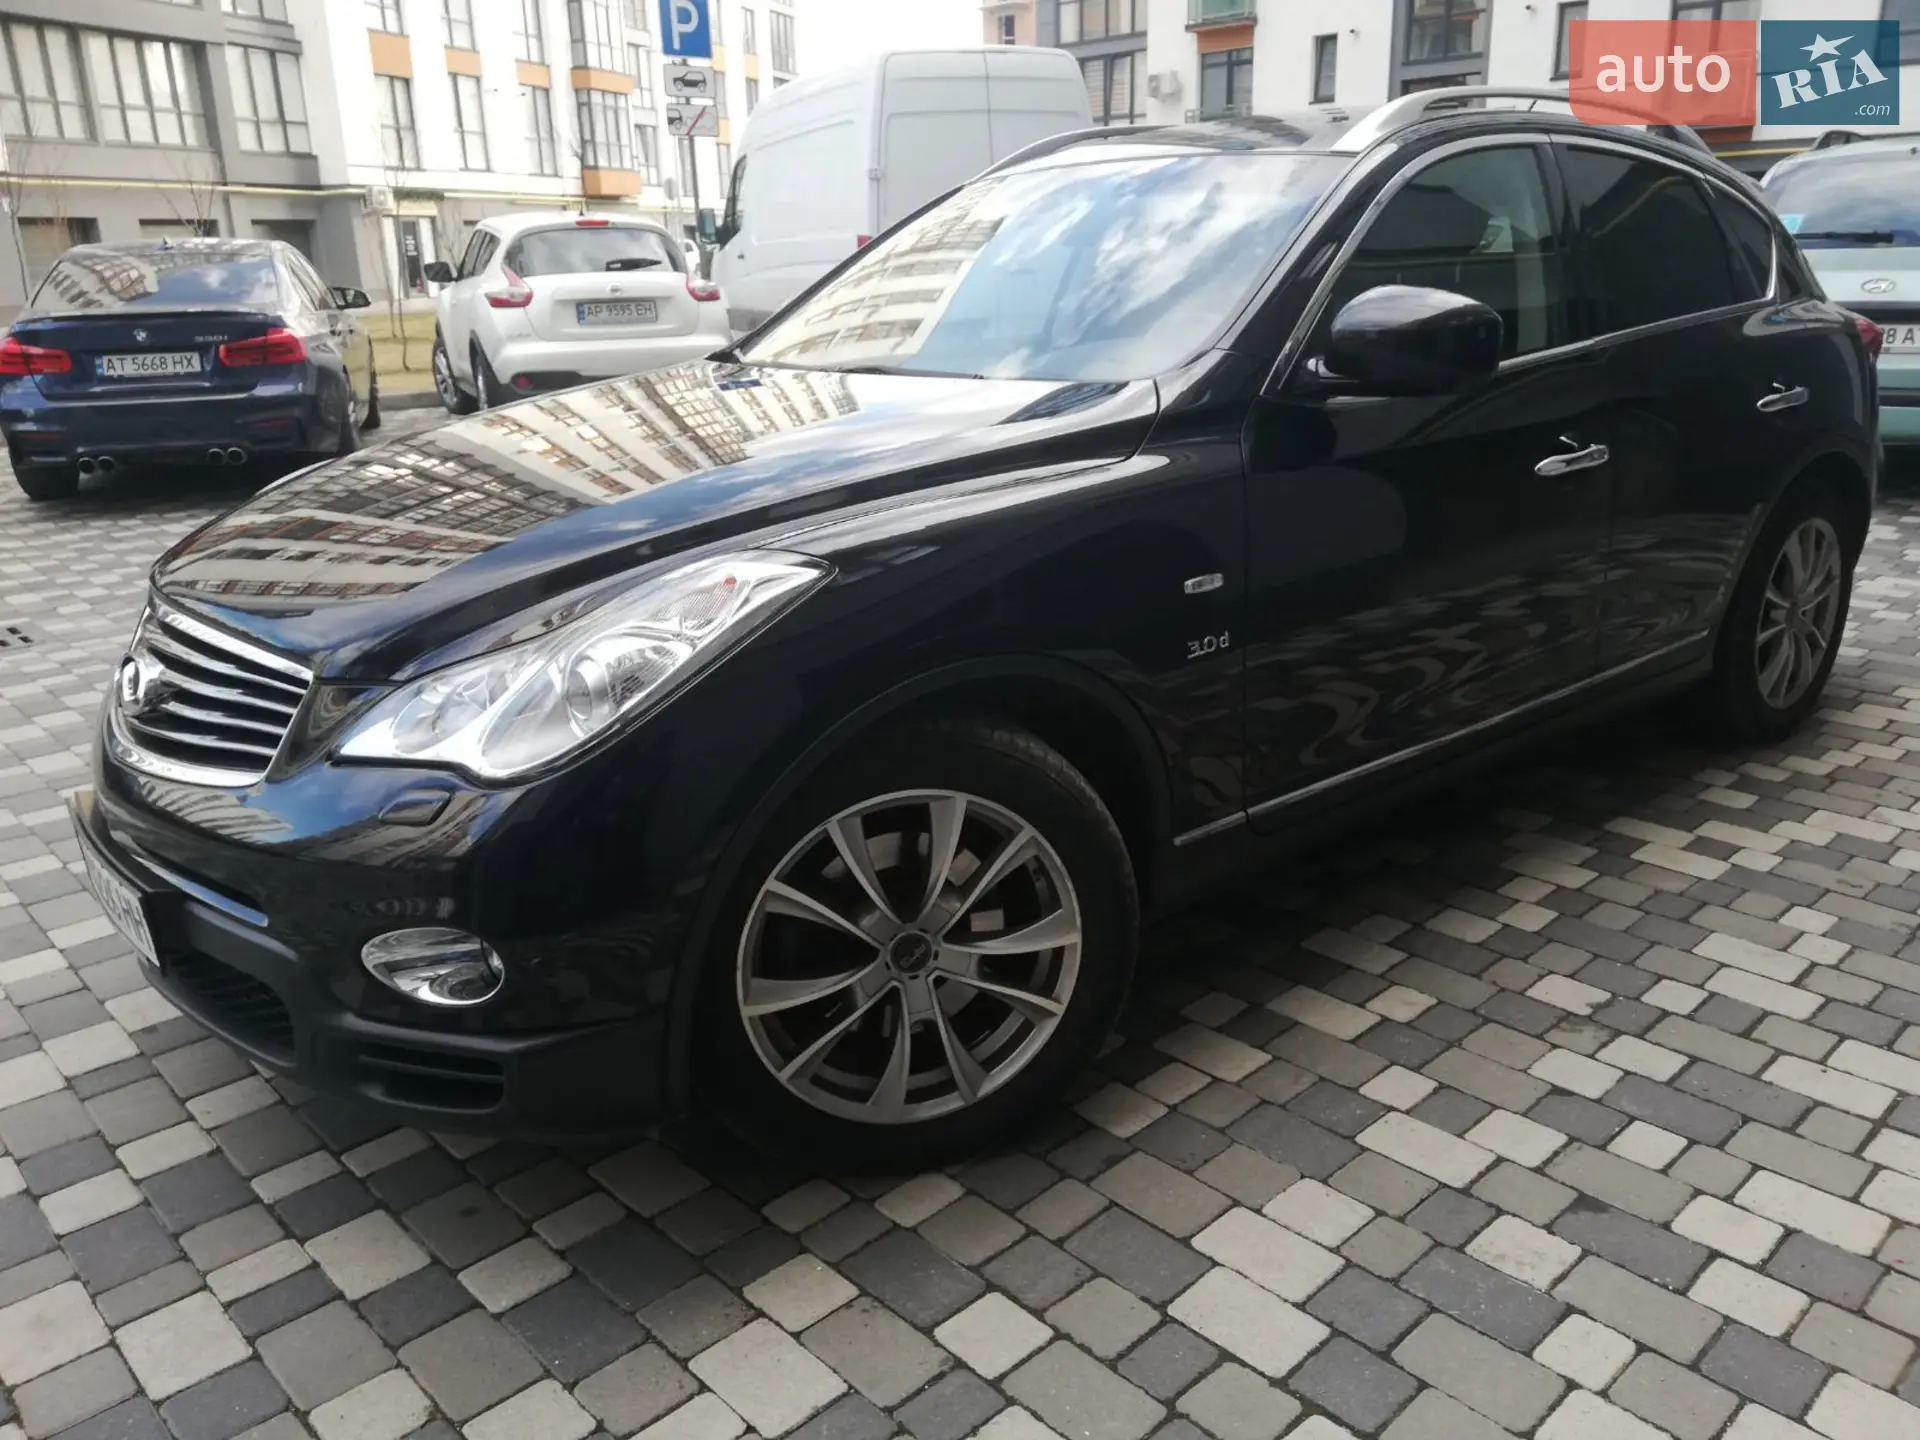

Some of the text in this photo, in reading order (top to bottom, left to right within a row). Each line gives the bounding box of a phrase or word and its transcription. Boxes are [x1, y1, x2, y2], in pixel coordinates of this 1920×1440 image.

[670, 0, 699, 50] P
[588, 304, 603, 317] AP
[605, 303, 632, 317] 9595
[106, 355, 196, 373] AT 5668 HX
